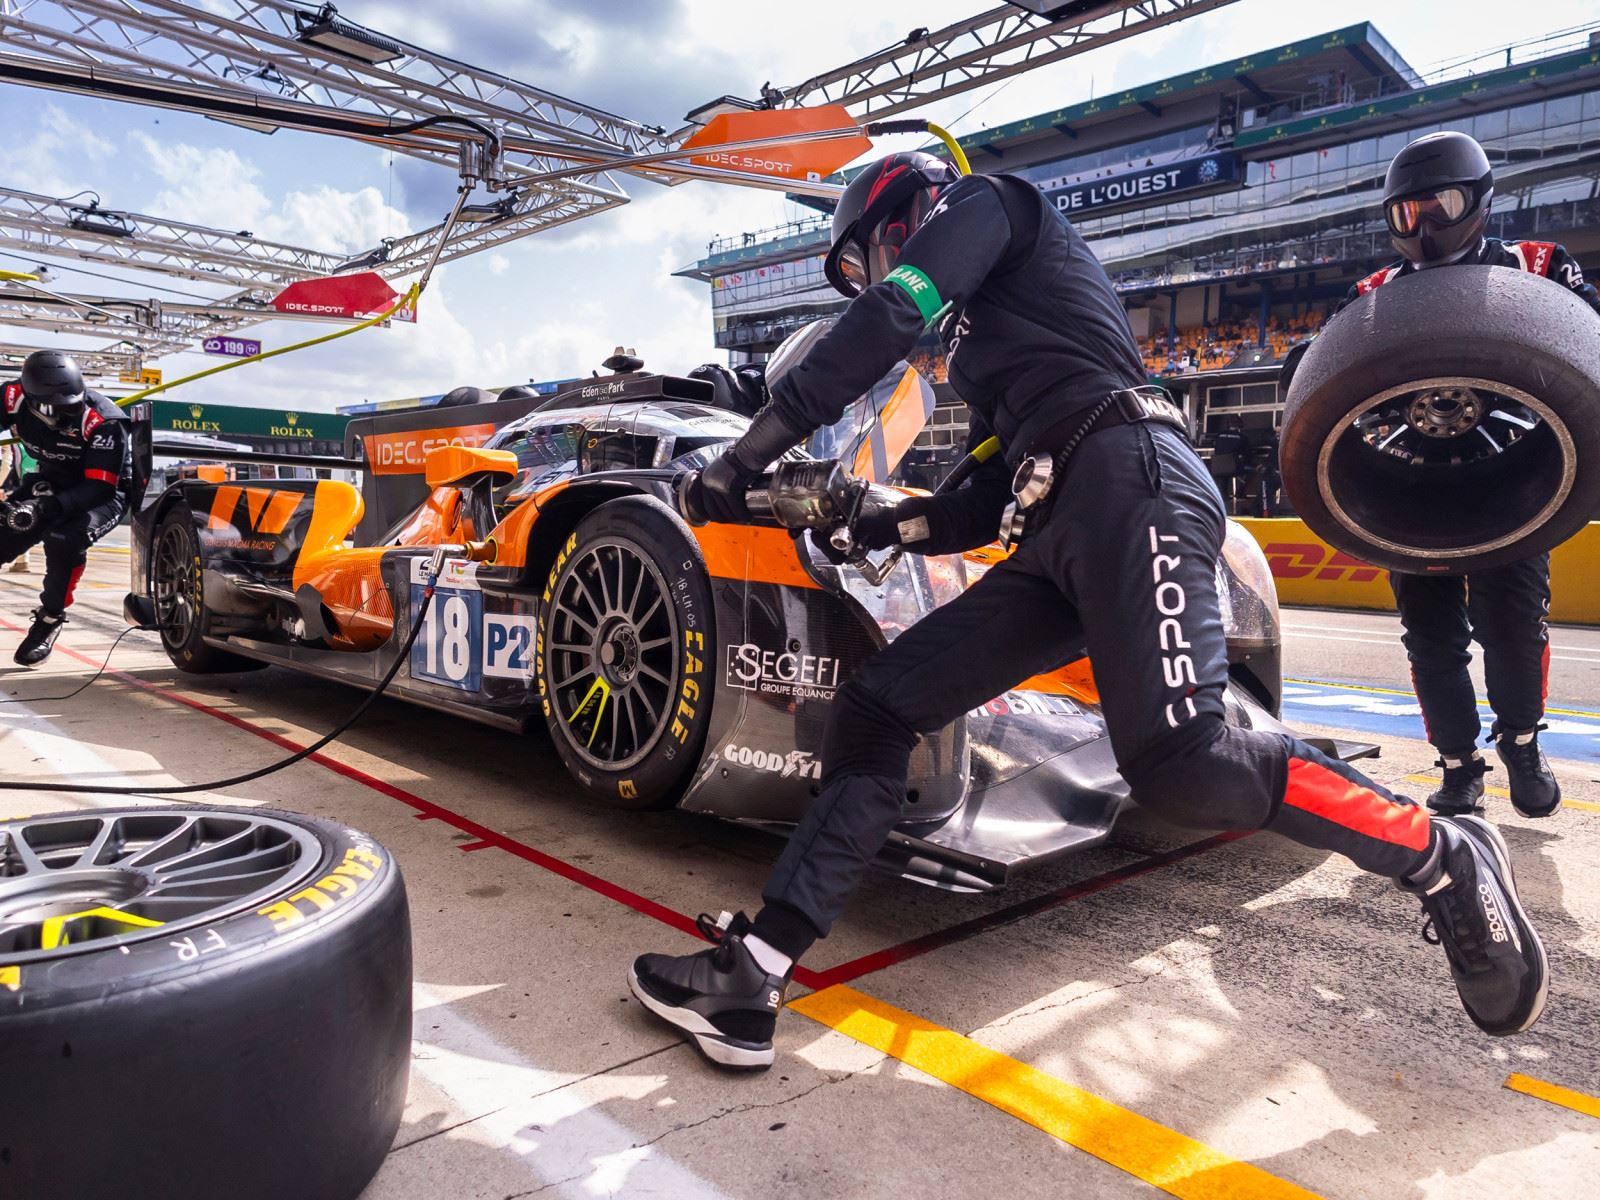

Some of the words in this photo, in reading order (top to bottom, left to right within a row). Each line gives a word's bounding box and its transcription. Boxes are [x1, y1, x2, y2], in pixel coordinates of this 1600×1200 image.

[705, 153, 793, 174] IDEC.SPORT
[1056, 191, 1084, 211] DE
[1090, 169, 1182, 204] L'OUEST
[285, 302, 345, 314] IDEC.SPORT
[223, 341, 244, 355] 199
[581, 385, 599, 398] Eden
[608, 380, 625, 394] Park
[172, 418, 221, 432] ROLEX
[270, 426, 314, 438] ROLEX
[417, 593, 470, 681] 18
[487, 622, 531, 670] P2
[735, 643, 840, 686] SEGEFI
[671, 629, 705, 746] EAGLE
[760, 682, 791, 695] GROUPE
[257, 846, 383, 932] EAGLE
[1478, 883, 1509, 943] sparco
[169, 928, 228, 963] FR
